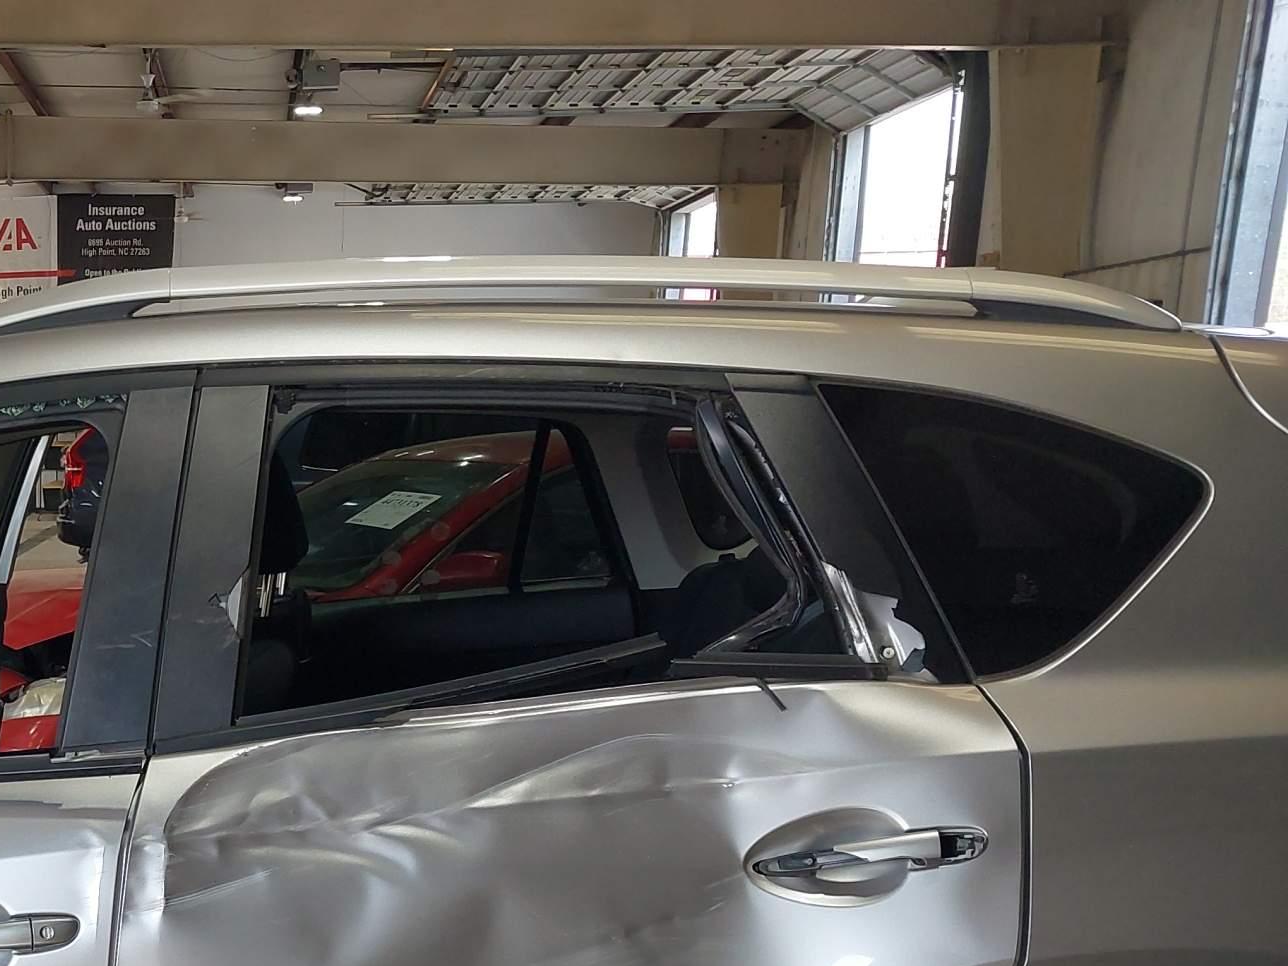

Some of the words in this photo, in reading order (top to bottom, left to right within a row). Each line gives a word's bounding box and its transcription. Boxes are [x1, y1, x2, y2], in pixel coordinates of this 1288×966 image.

[88, 203, 145, 216] Insurance
[76, 218, 103, 231] Auto
[105, 218, 156, 231] Auctions
[105, 238, 131, 247] Auction
[132, 238, 144, 247] Rd.
[81, 248, 97, 257] High
[98, 248, 116, 256] Point,
[118, 248, 129, 256] NC
[84, 268, 102, 279] Open
